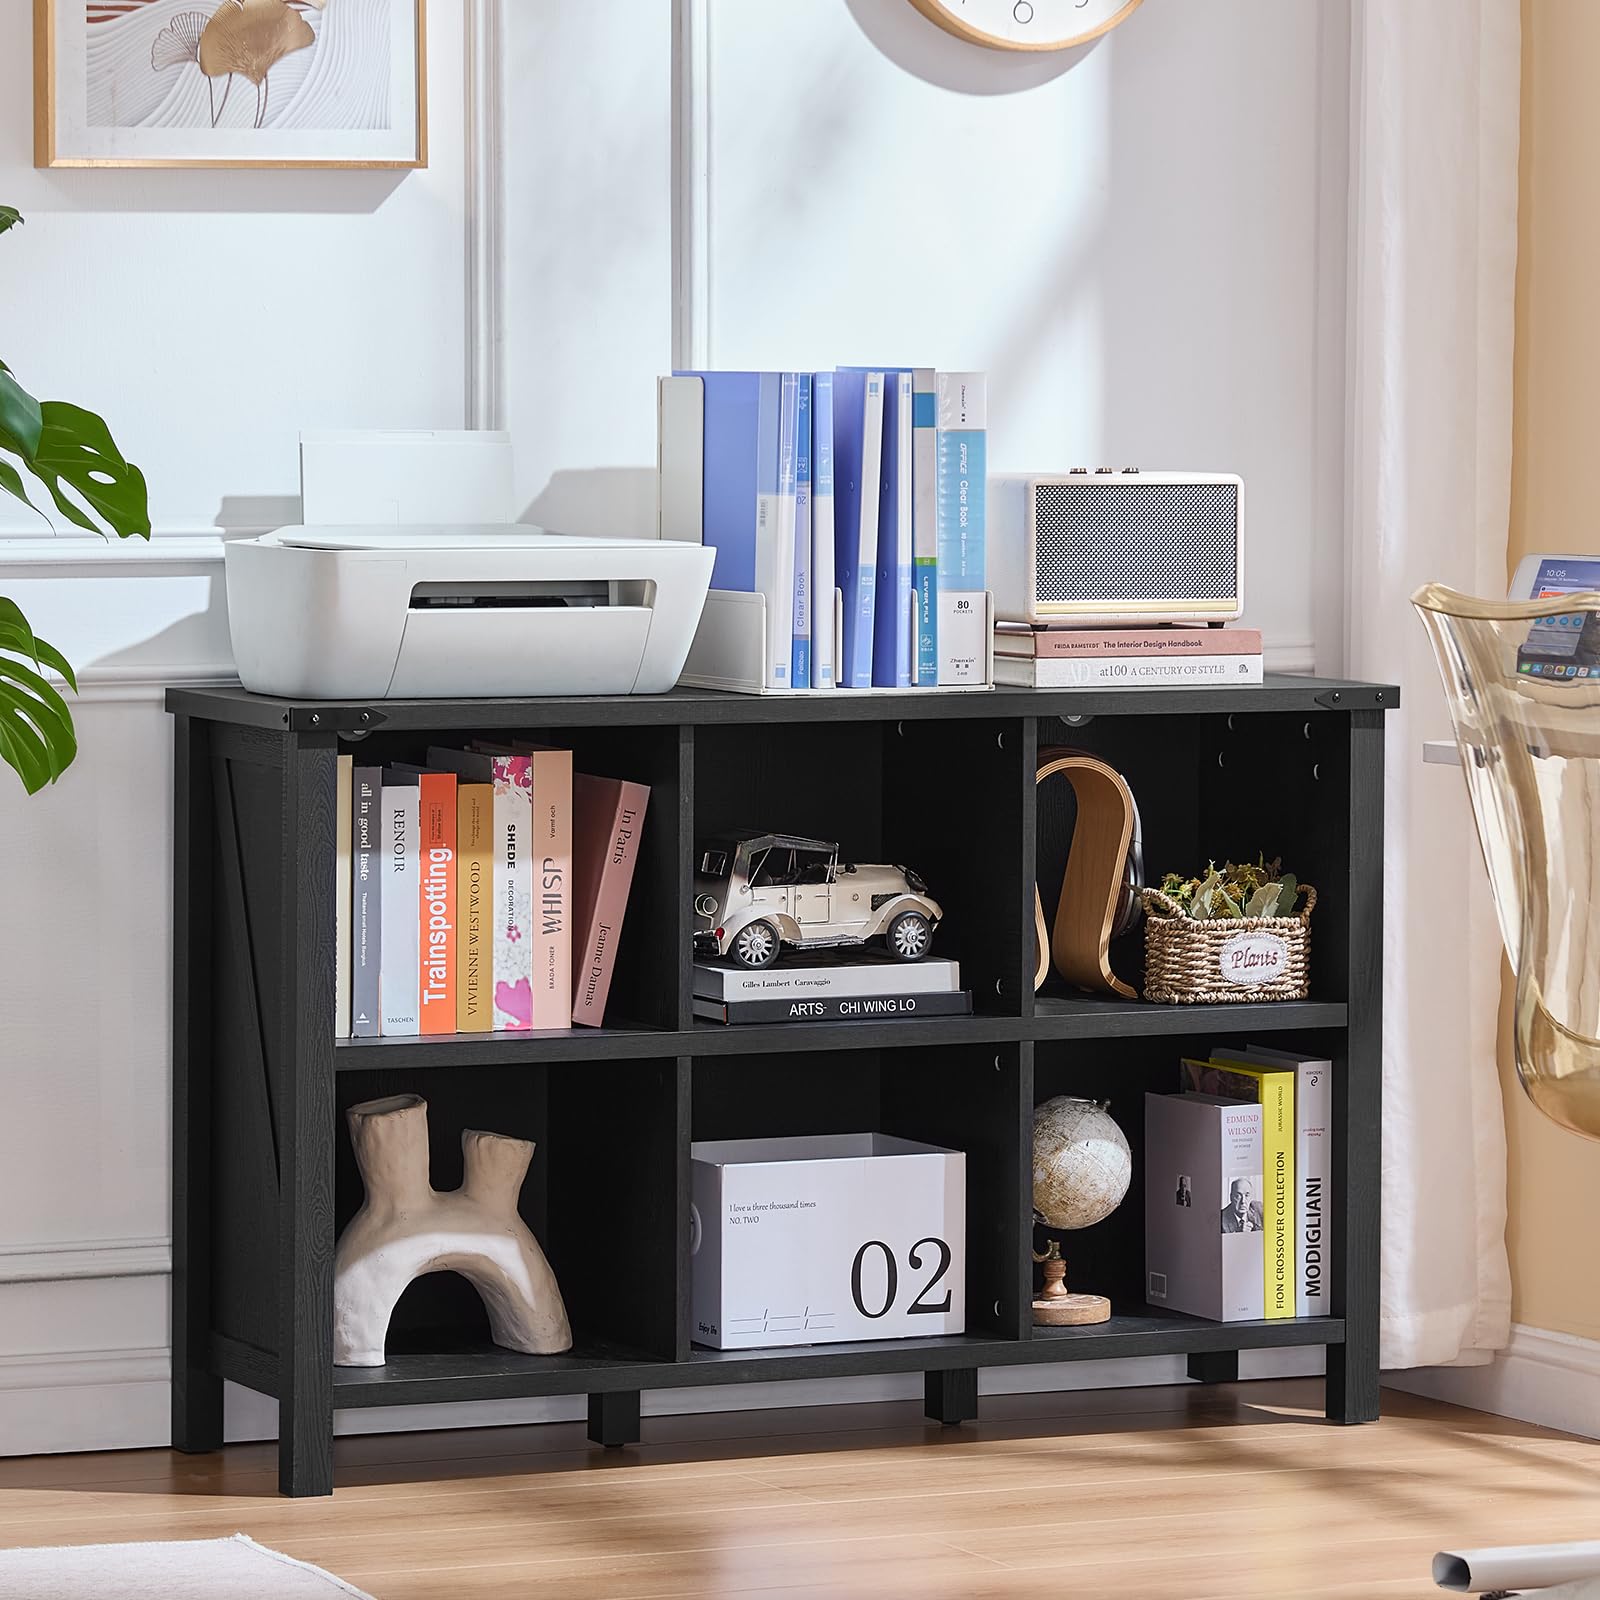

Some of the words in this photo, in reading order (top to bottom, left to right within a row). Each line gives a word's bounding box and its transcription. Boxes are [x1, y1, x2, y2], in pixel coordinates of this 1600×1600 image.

[960, 480, 969, 504] Clear
[960, 506, 969, 528] Book
[796, 570, 805, 596] Book
[1546, 569, 1567, 577] 10:05
[796, 600, 805, 627] Clear
[957, 600, 969, 610] 80
[1103, 641, 1116, 649] The
[1117, 640, 1142, 649] Interior
[1143, 640, 1167, 650] Design
[1168, 639, 1203, 648] Handbook
[1130, 667, 1138, 676] A
[1138, 666, 1183, 676] CENTURY
[1183, 665, 1198, 675] OF
[1198, 665, 1225, 675] STYLE
[361, 783, 373, 797] all
[361, 801, 372, 813] in
[621, 808, 637, 824] In
[358, 818, 372, 849] good
[393, 808, 406, 873] RENOIR
[507, 824, 516, 869] SHEDE
[613, 828, 633, 865] Paris
[360, 853, 370, 881] taste
[469, 861, 481, 945] WESTWOOD
[507, 880, 515, 932] DECORATION
[542, 857, 563, 935] WHISP
[594, 922, 612, 964] Jeanne
[1231, 946, 1279, 969] Plants
[468, 948, 479, 1015] VIVIENNE
[585, 966, 603, 1007] Damas
[762, 979, 790, 988] Lambert
[794, 978, 831, 986] Caravaggio
[839, 1000, 861, 1014] CHI
[863, 999, 897, 1013] WING
[899, 998, 916, 1012] LO
[387, 1016, 414, 1024] TASCHEN
[1226, 1114, 1259, 1124] EDMUND
[1228, 1126, 1257, 1136] WILSON
[1276, 1151, 1285, 1216] COLLECTION
[728, 1204, 732, 1212] I
[733, 1203, 746, 1212] love
[752, 1202, 769, 1211] three
[769, 1200, 799, 1210] thousand
[799, 1201, 817, 1209] times
[743, 1215, 760, 1224] TWO
[1276, 1218, 1285, 1281] CROSSOVER
[1305, 1177, 1321, 1297] MODIGLIANI
[850, 1237, 952, 1319] 02
[1276, 1284, 1284, 1309] FION
